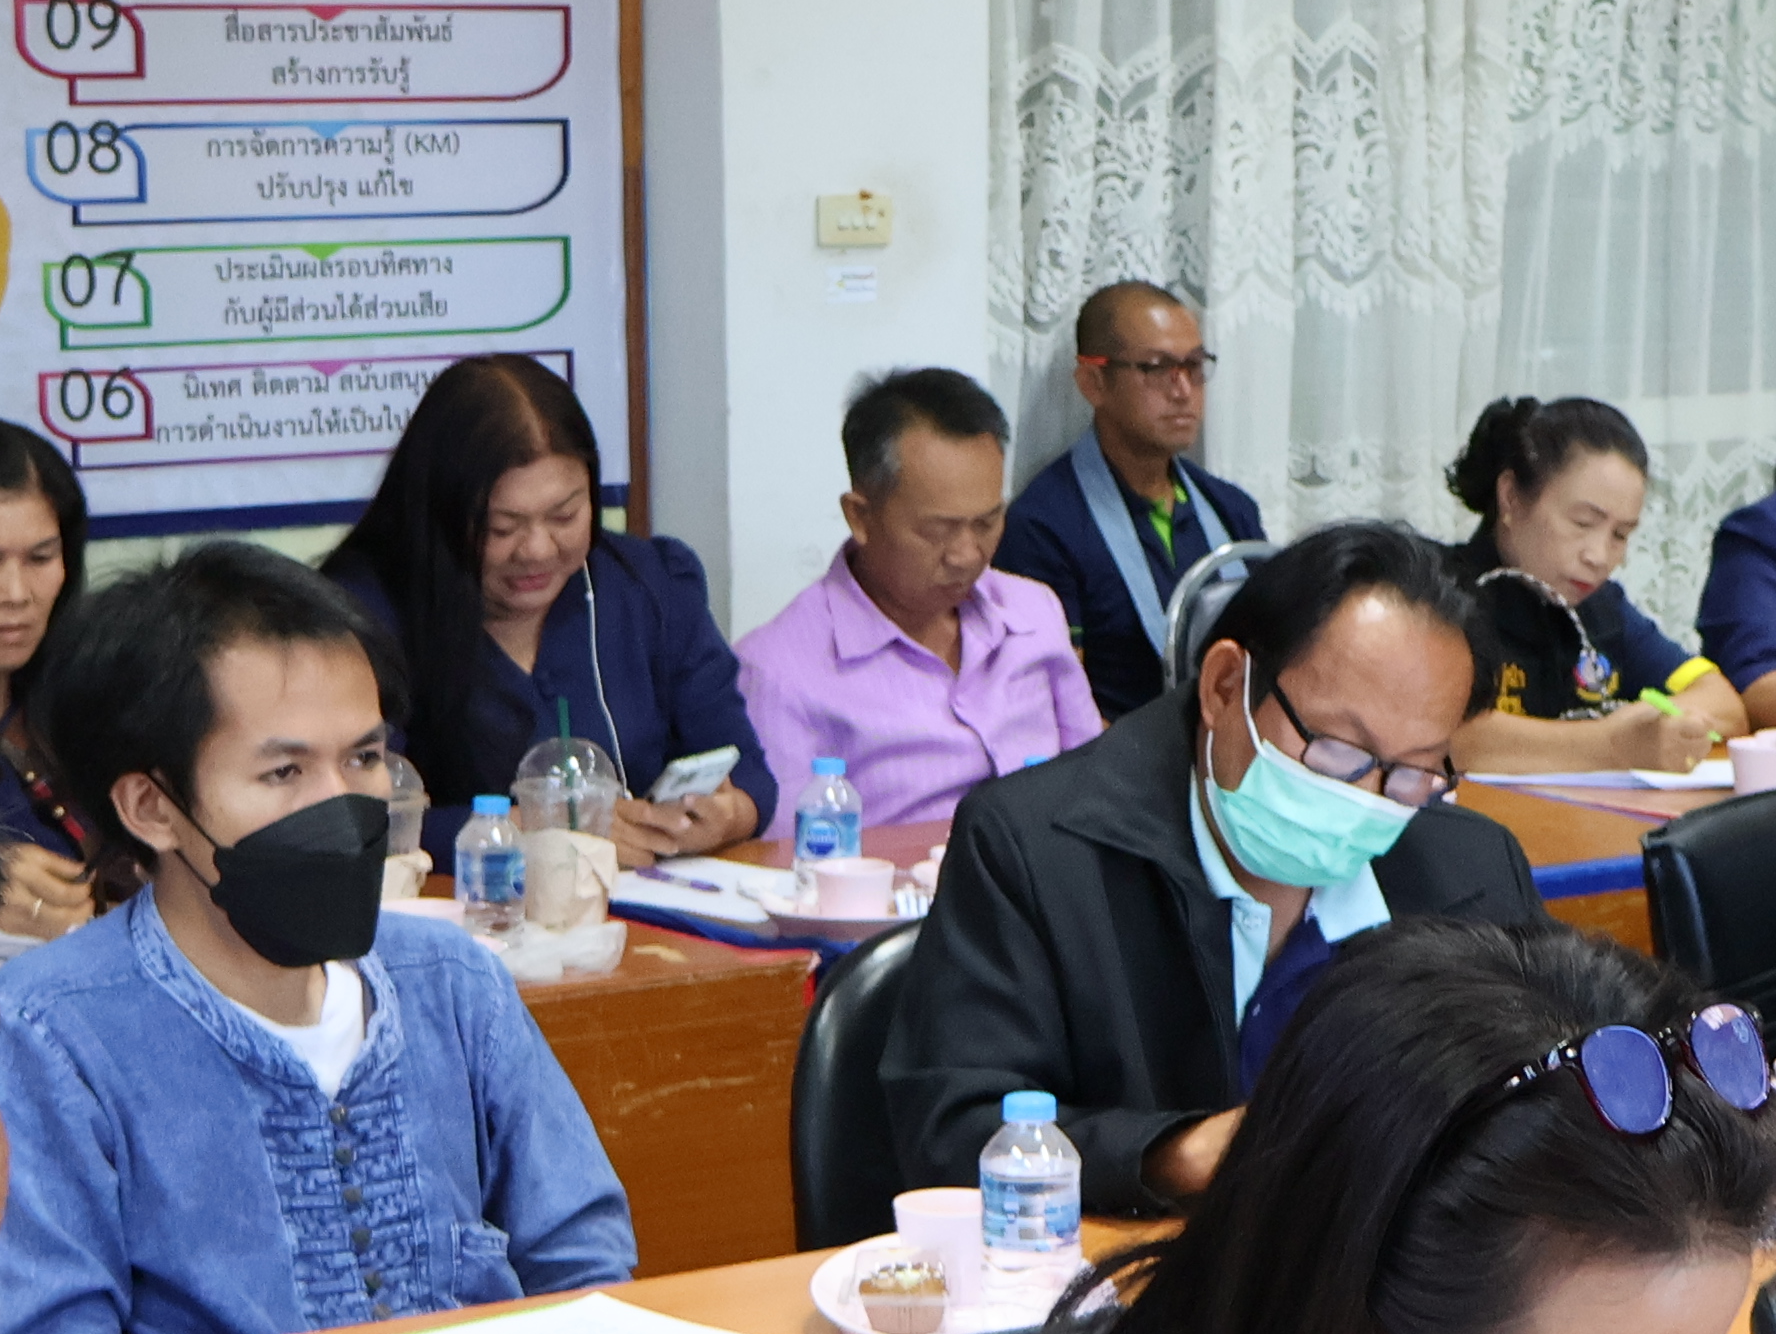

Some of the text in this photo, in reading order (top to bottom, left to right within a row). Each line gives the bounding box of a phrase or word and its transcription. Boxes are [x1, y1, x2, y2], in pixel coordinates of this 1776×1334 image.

[45, 120, 122, 175] 08
[404, 130, 460, 157] (KM)
[60, 251, 136, 308] 07
[60, 366, 135, 422] 06
